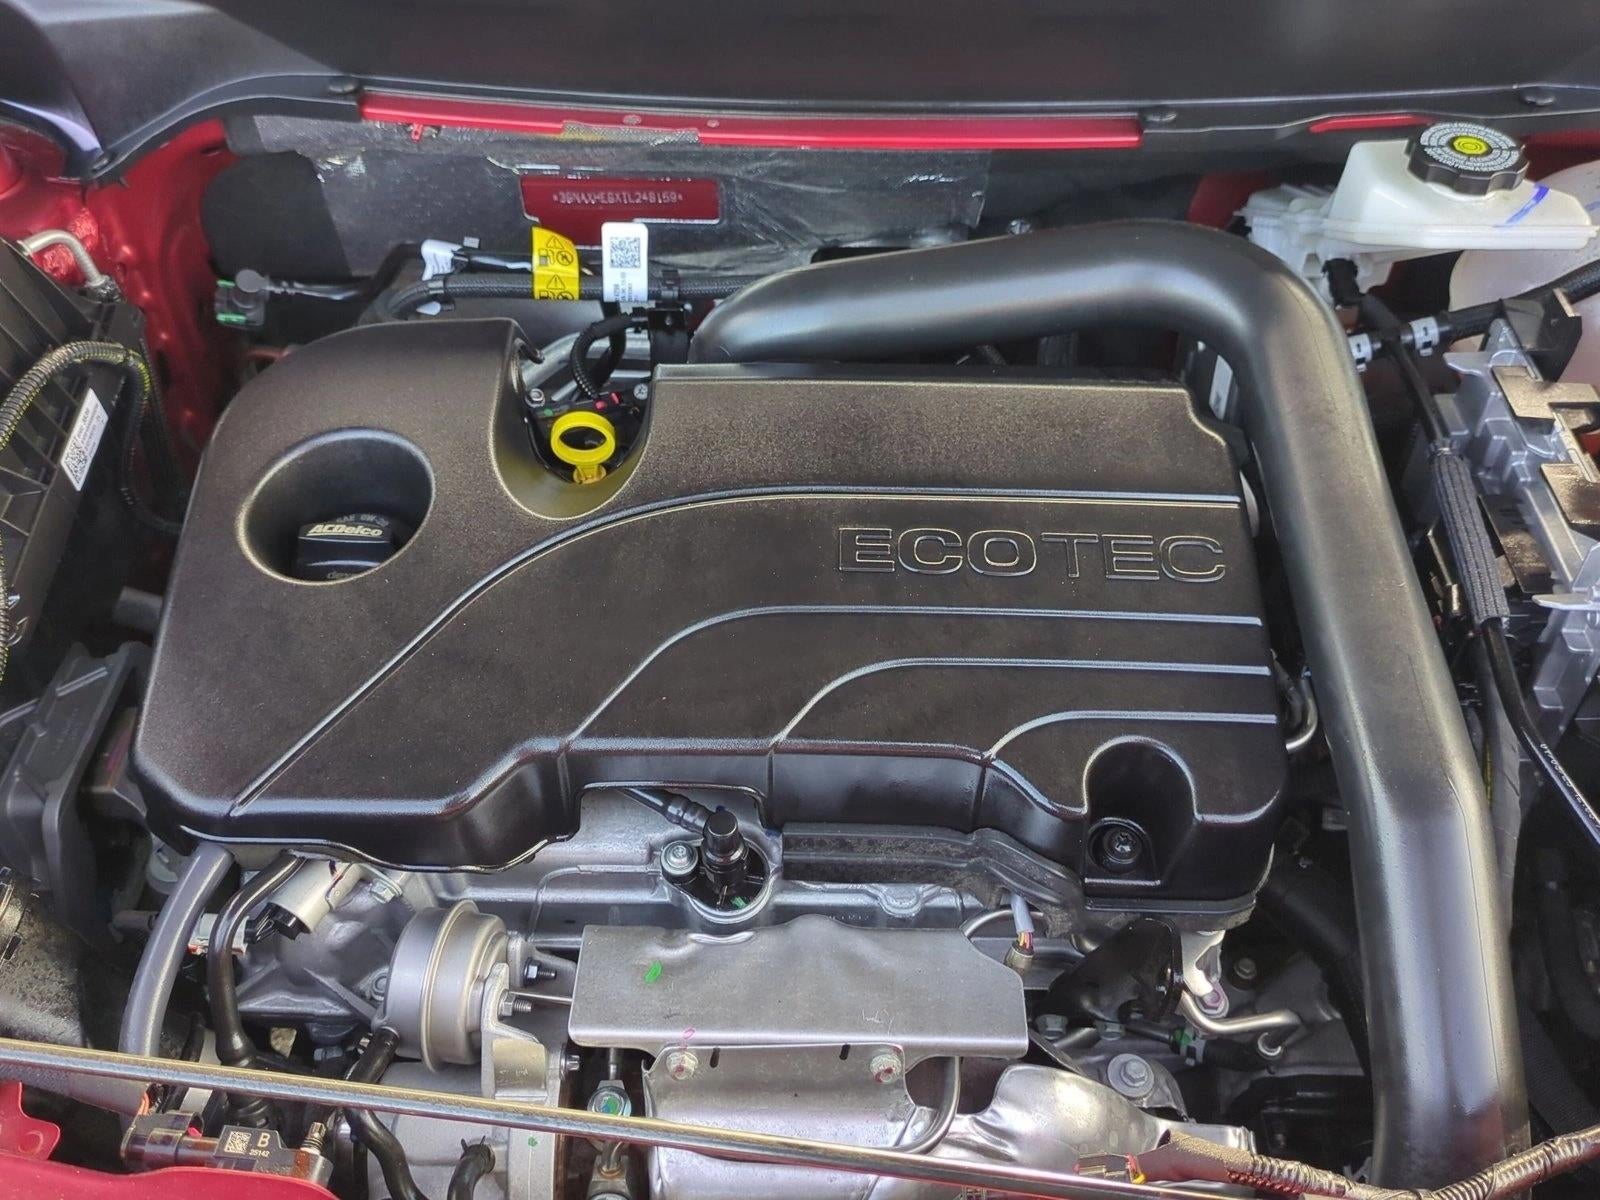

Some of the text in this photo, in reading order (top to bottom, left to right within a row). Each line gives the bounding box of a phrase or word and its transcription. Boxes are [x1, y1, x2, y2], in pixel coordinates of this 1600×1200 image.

[308, 524, 383, 536] ACDelco
[838, 527, 1226, 583] ECOTEC
[257, 1132, 270, 1148] B
